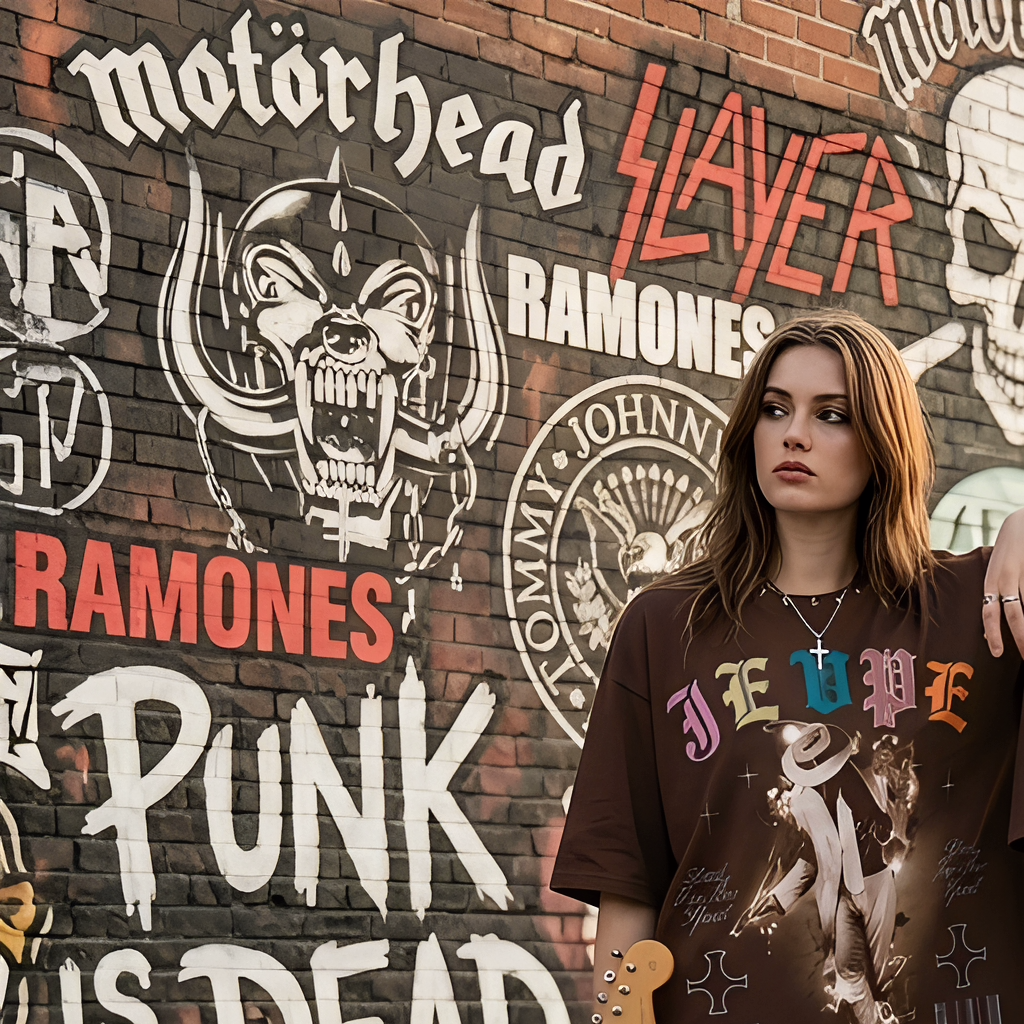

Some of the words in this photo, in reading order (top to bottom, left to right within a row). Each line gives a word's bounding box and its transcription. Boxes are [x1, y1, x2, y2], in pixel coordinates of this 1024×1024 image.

[608, 62, 914, 306] SLAYER
[507, 253, 776, 380] RAMONES
[13, 529, 395, 664] RAMONES
[513, 462, 576, 696] TOMMY
[51, 655, 515, 932] PUNK
